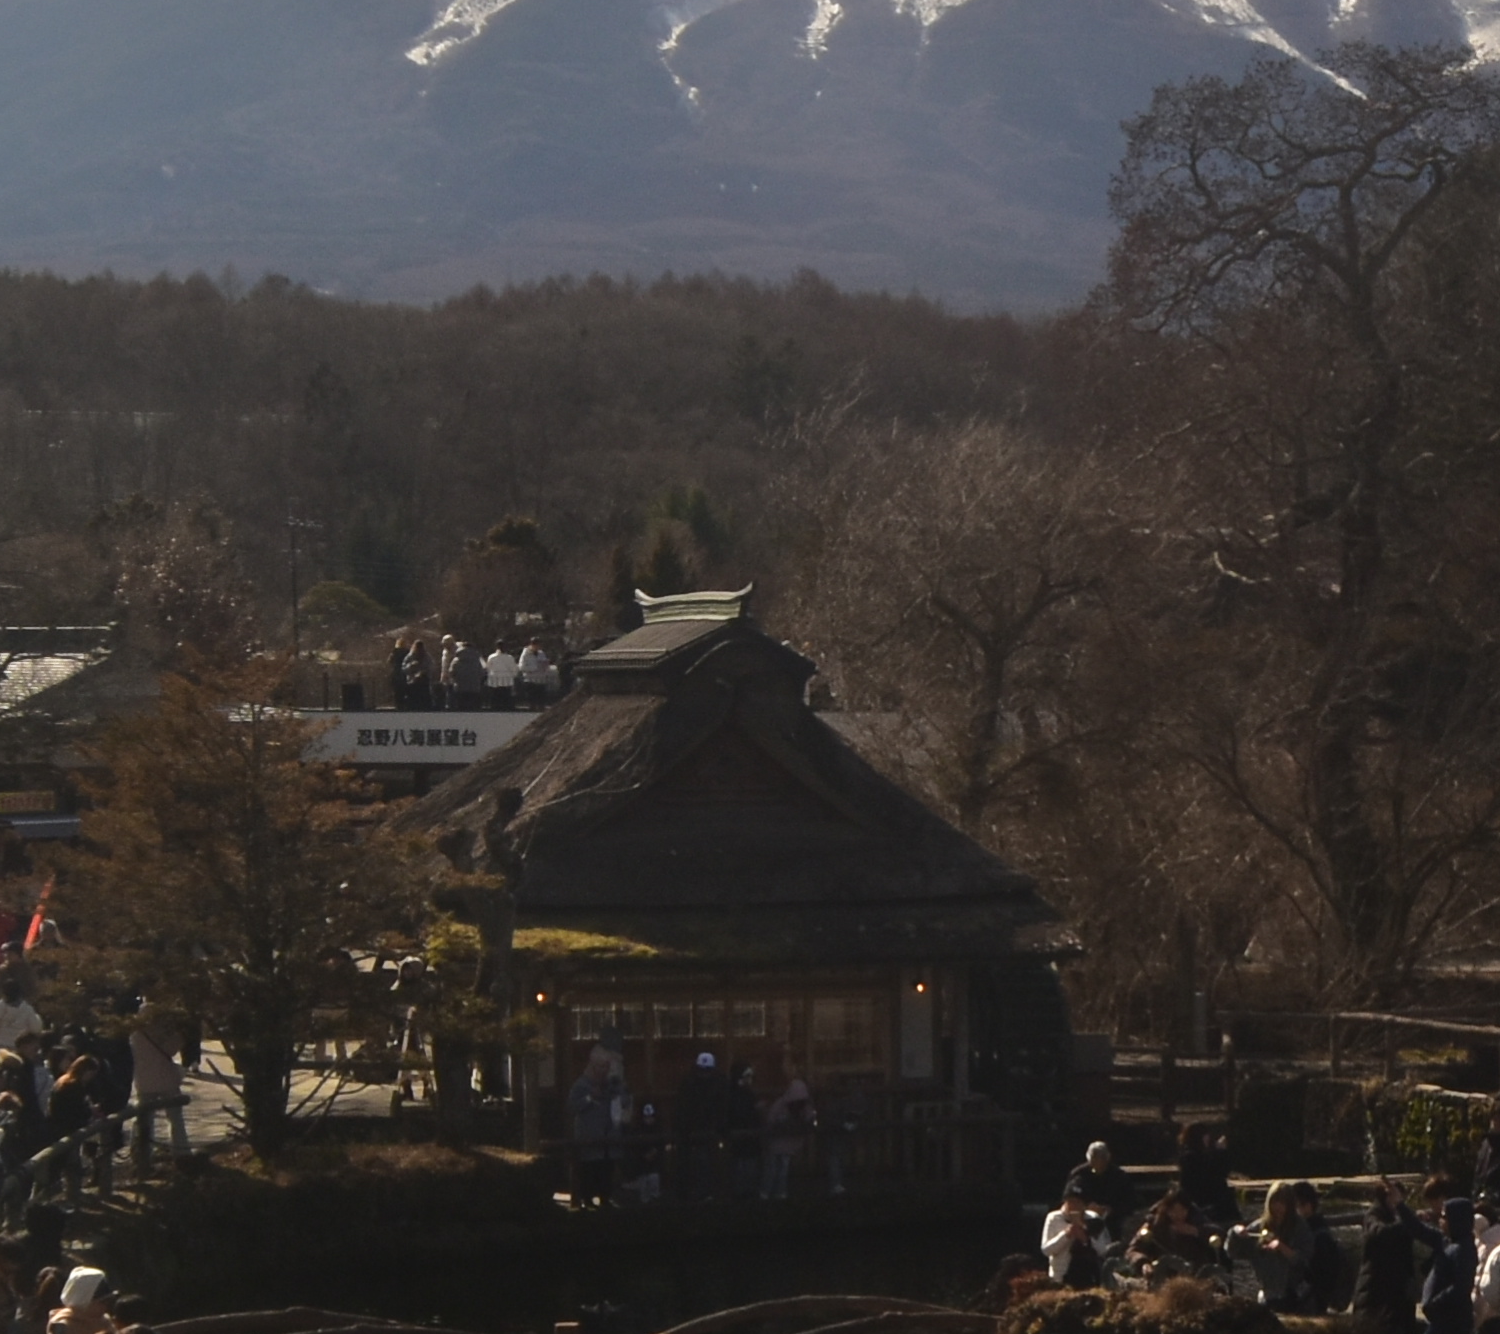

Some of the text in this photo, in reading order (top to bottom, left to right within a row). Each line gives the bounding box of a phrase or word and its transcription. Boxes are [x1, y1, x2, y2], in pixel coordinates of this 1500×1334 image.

[357, 729, 477, 746] 忍野八海展望台
